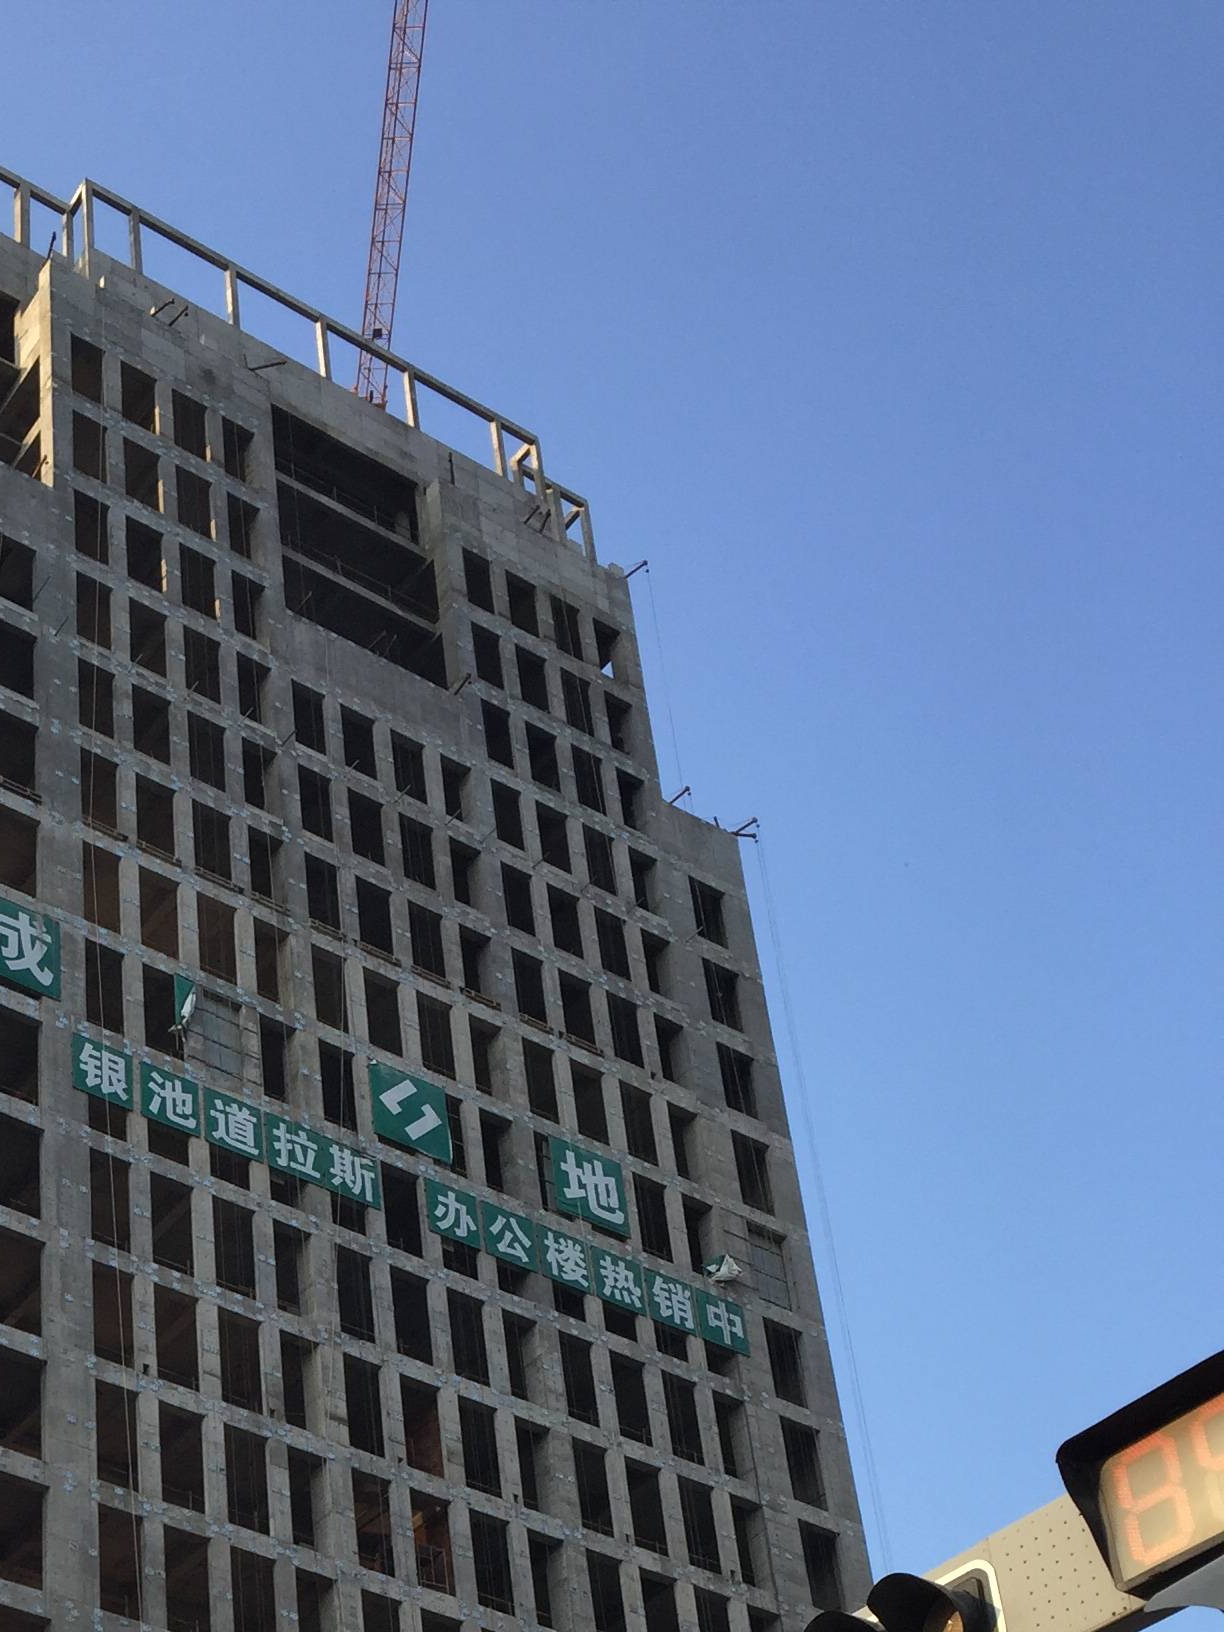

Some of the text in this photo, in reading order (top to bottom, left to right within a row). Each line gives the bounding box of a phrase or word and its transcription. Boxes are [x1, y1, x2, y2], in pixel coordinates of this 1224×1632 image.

[78, 1041, 746, 1346] 银池道拉斯 办公楼热销中
